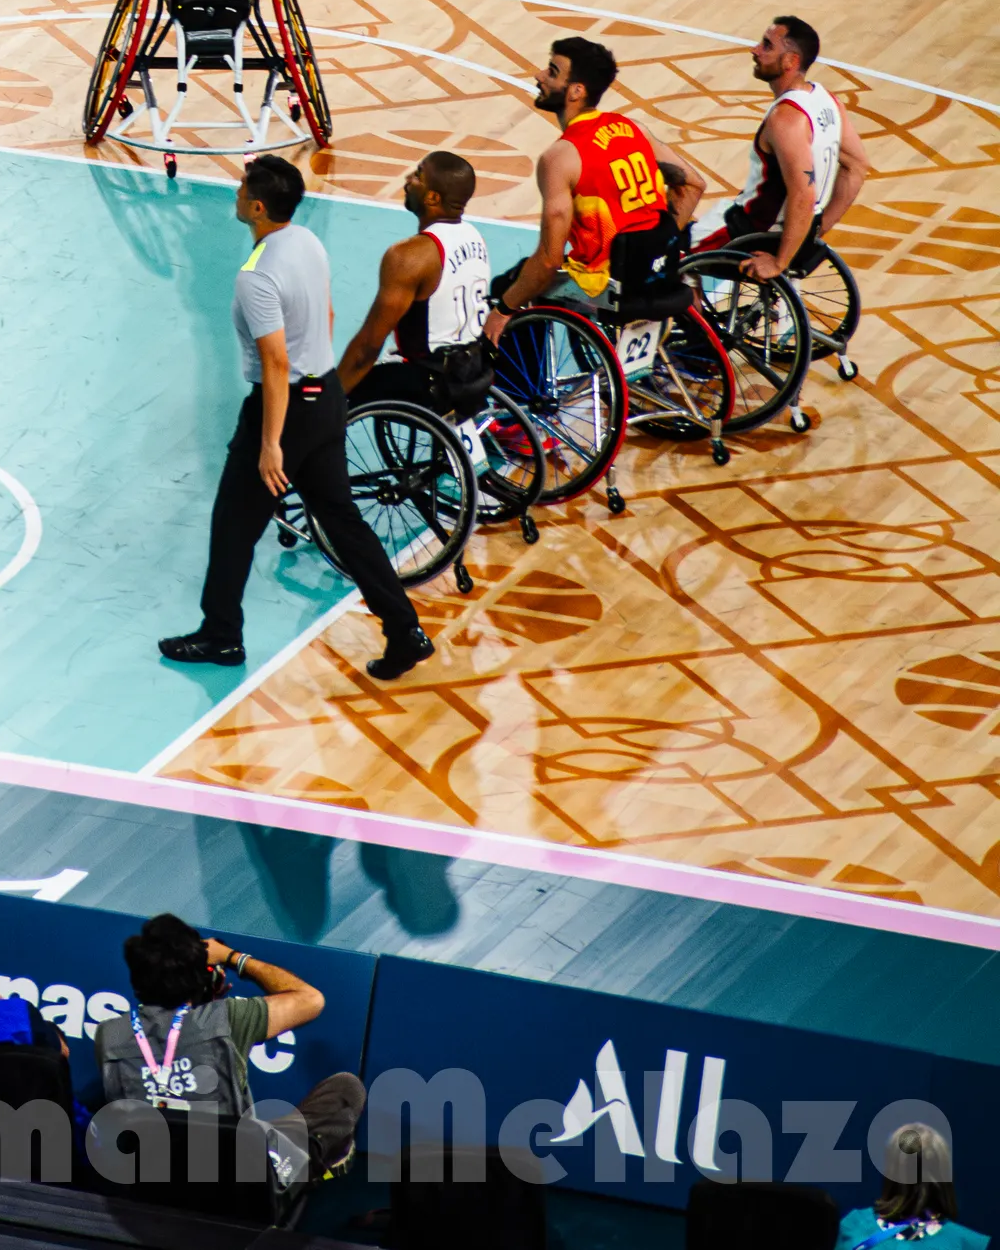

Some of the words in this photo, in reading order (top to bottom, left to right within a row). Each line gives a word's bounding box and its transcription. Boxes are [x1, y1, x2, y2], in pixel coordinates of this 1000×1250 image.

[592, 121, 635, 151] LORENZO
[609, 151, 658, 214] 22
[624, 332, 651, 364] 22
[141, 1057, 192, 1080] PTO
